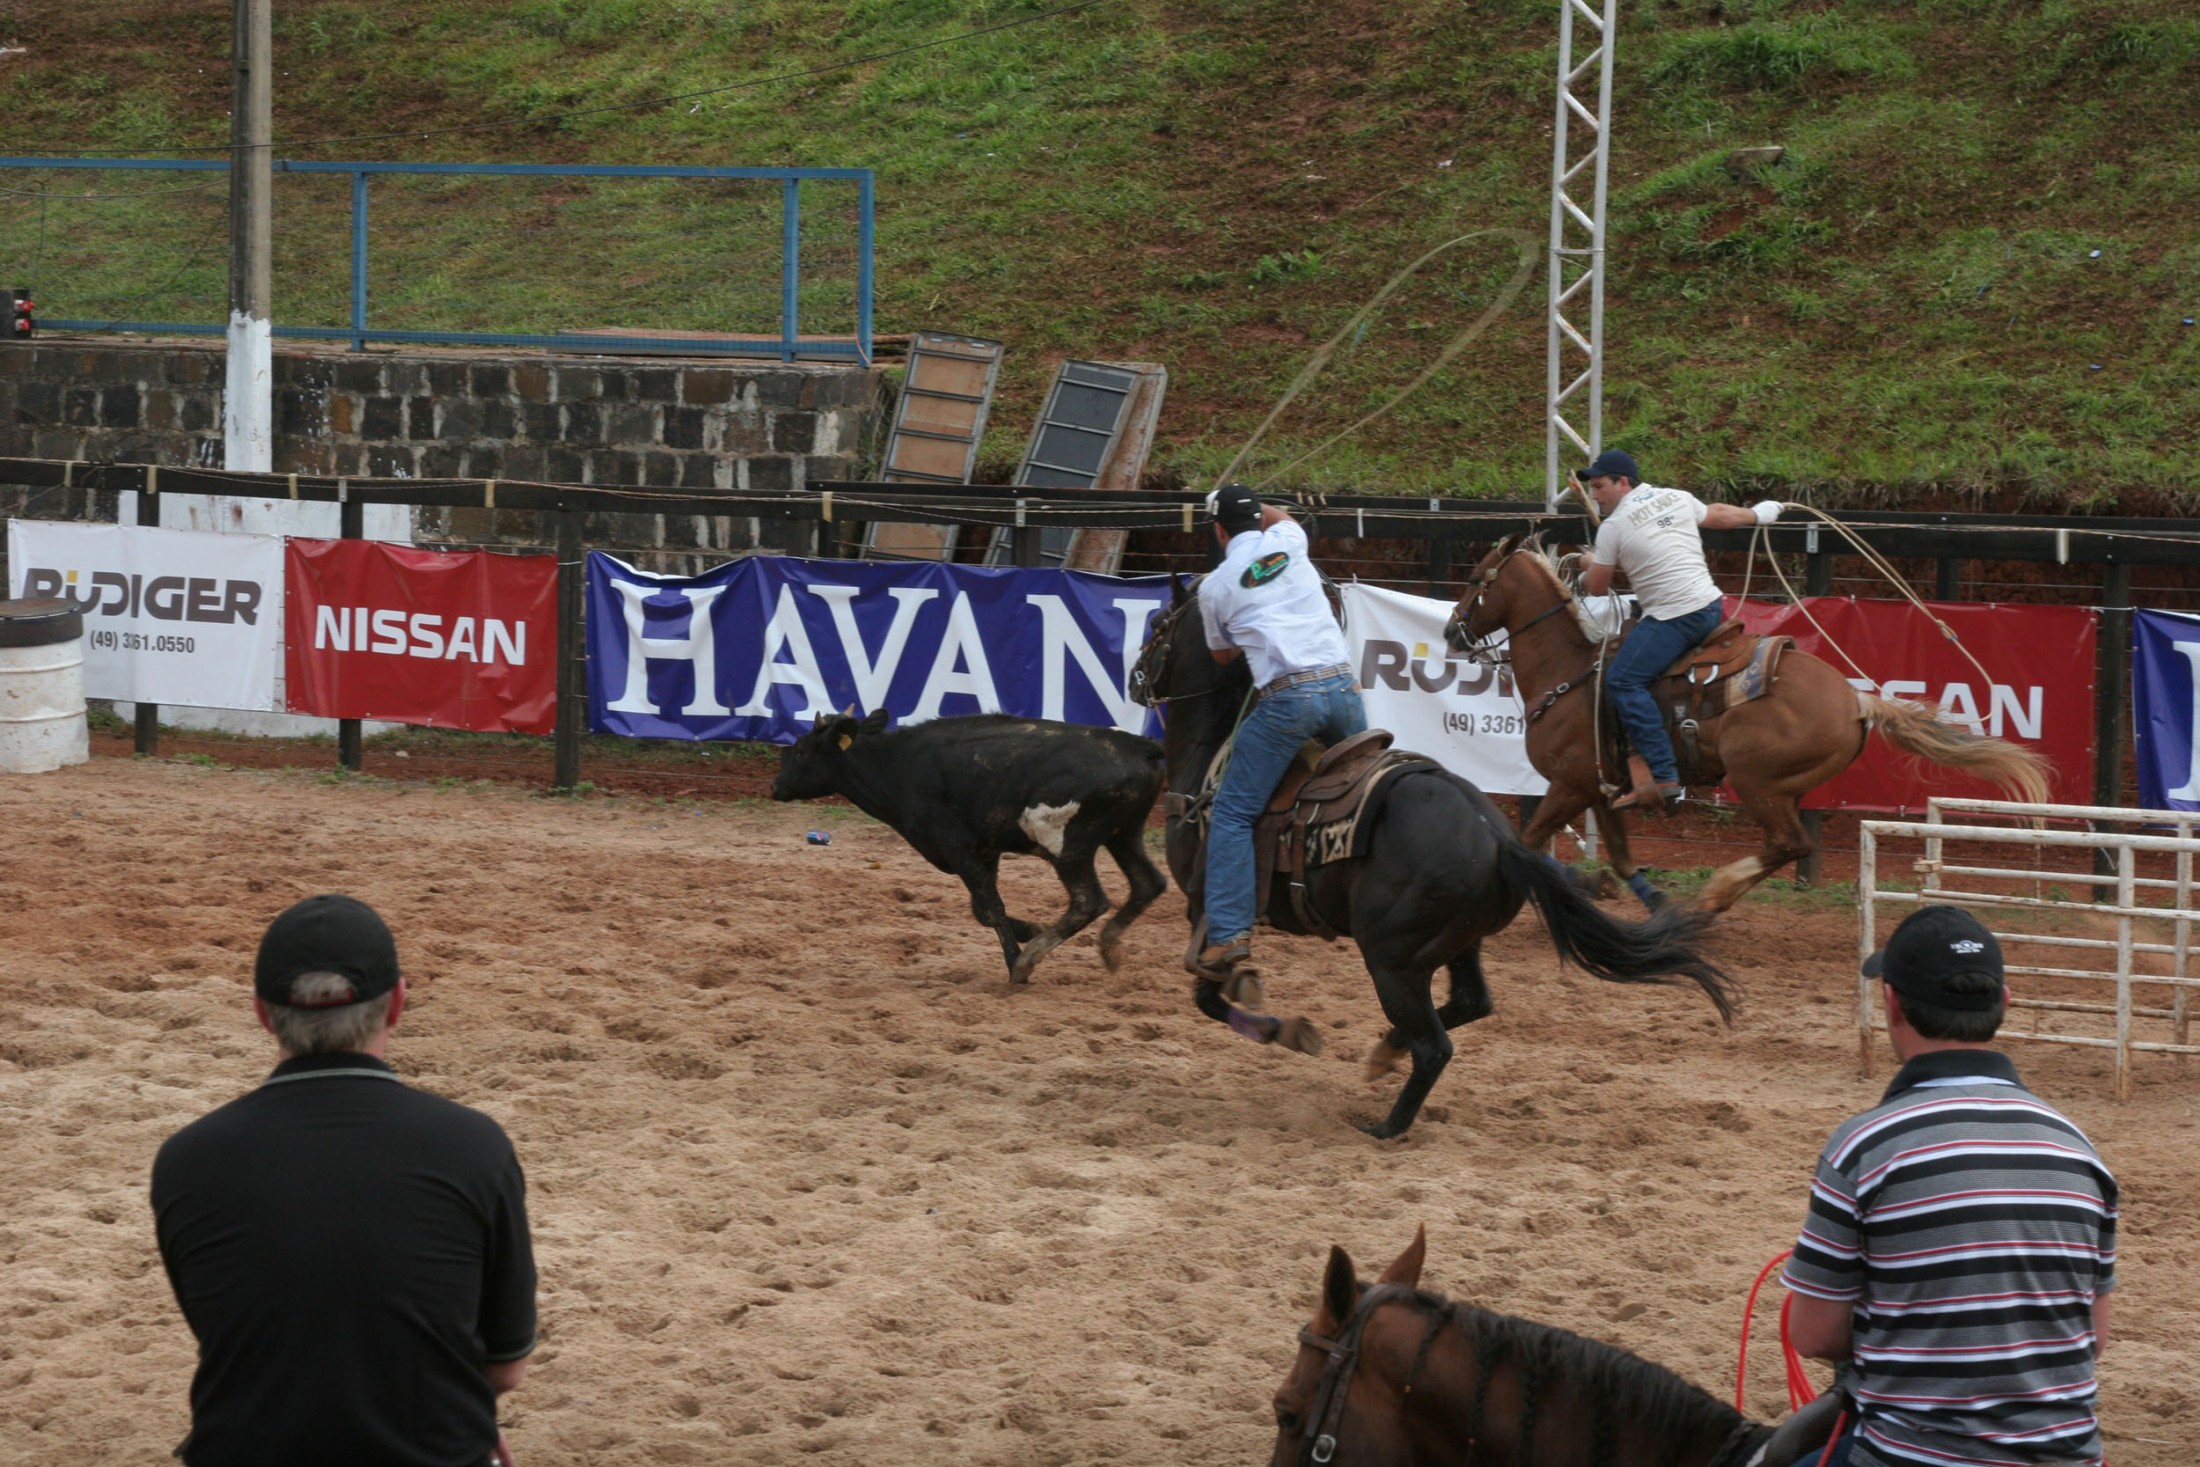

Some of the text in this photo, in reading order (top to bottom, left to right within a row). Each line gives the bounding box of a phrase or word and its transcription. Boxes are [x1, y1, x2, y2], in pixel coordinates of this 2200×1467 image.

[1627, 504, 1654, 526] HOT
[1650, 491, 1682, 512] SAUCE
[23, 568, 262, 626] RÜDIGER
[90, 629, 195, 654] (49) 361.0550
[315, 604, 526, 666] NISSAN
[607, 578, 1161, 735] HAVAN
[1443, 711, 1475, 736] (49)
